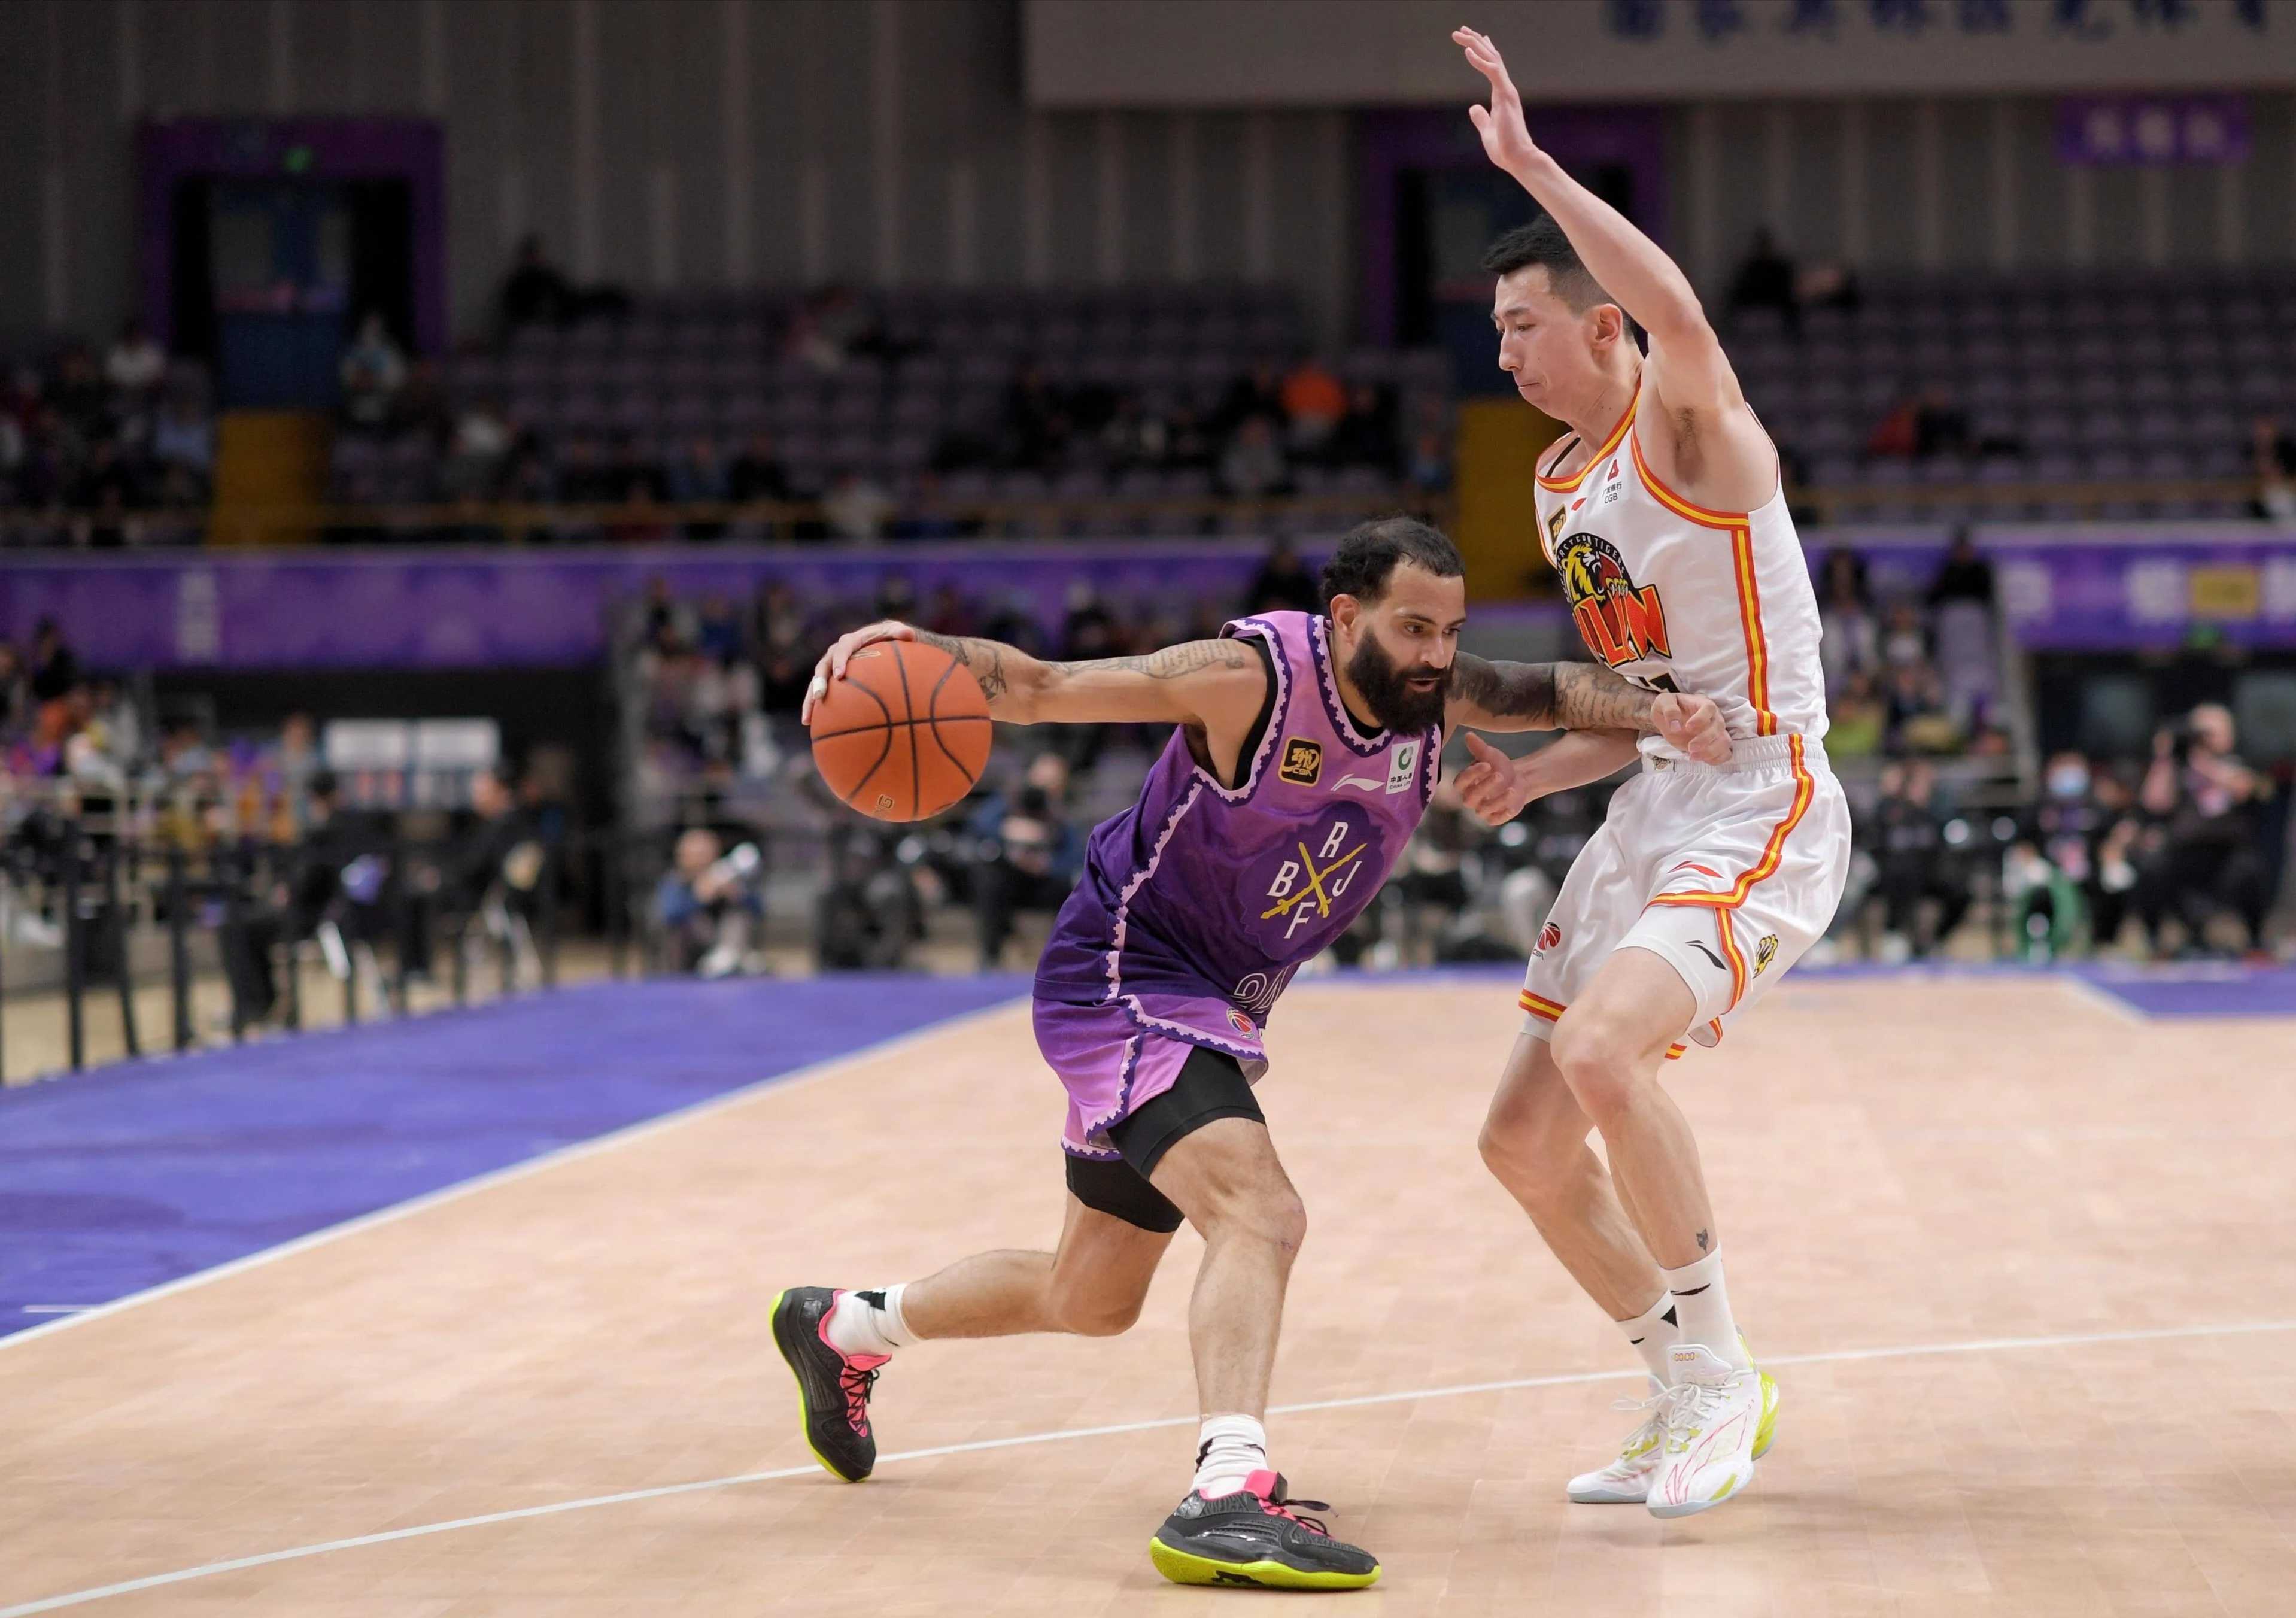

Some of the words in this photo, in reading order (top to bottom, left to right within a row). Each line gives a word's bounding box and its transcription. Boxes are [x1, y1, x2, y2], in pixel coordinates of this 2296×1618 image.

[1605, 493, 1618, 503] CGB
[1318, 821, 1348, 858] R
[1266, 861, 1300, 897] B
[1332, 861, 1363, 897] J
[1283, 901, 1317, 939] F
